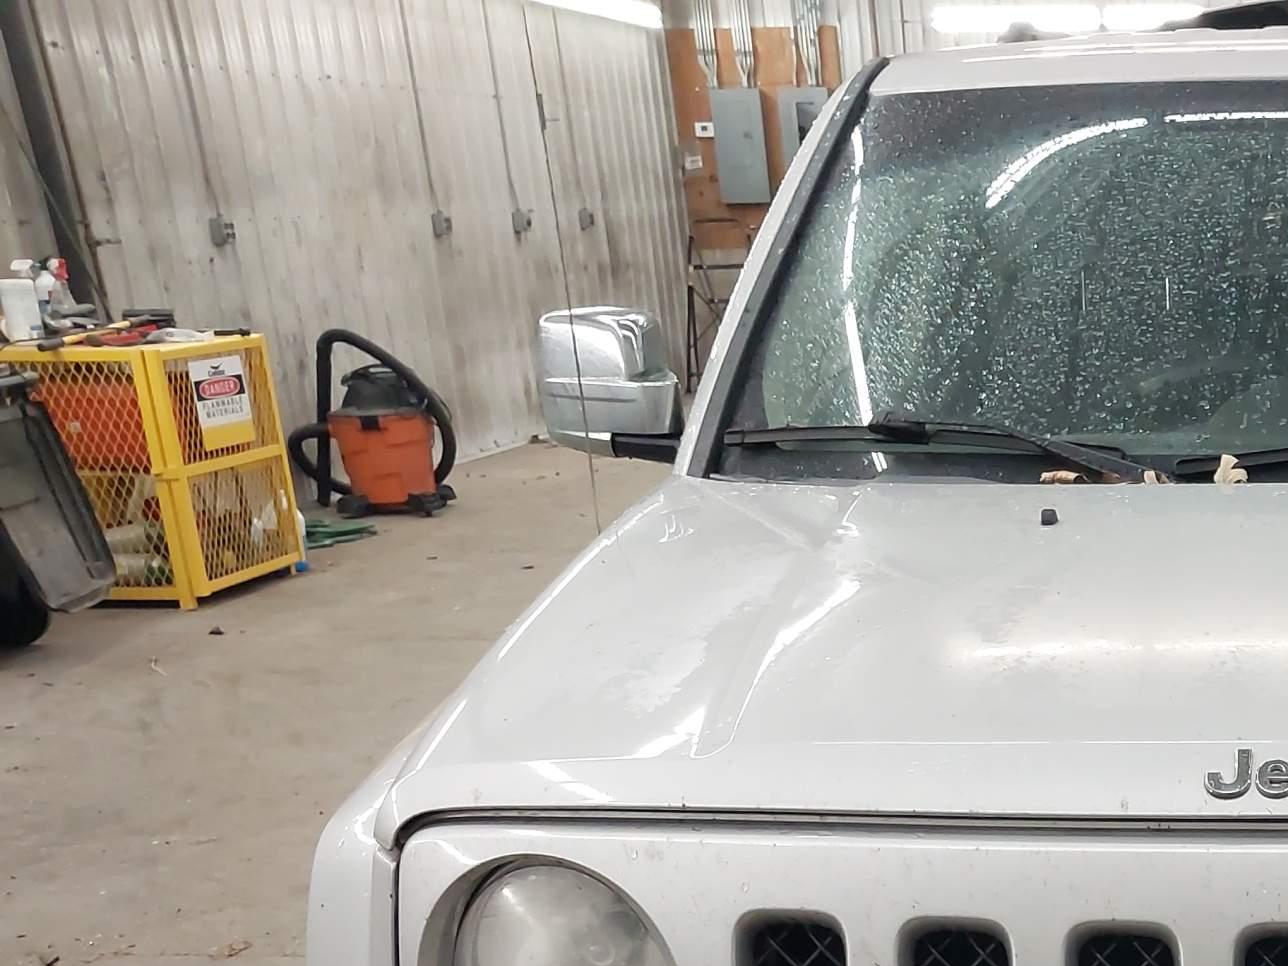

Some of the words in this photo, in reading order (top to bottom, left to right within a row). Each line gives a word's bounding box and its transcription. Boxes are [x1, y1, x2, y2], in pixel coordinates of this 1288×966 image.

[204, 380, 236, 396] DANGER
[202, 396, 243, 410] FLAMMABLE
[206, 406, 244, 418] MATERIALS
